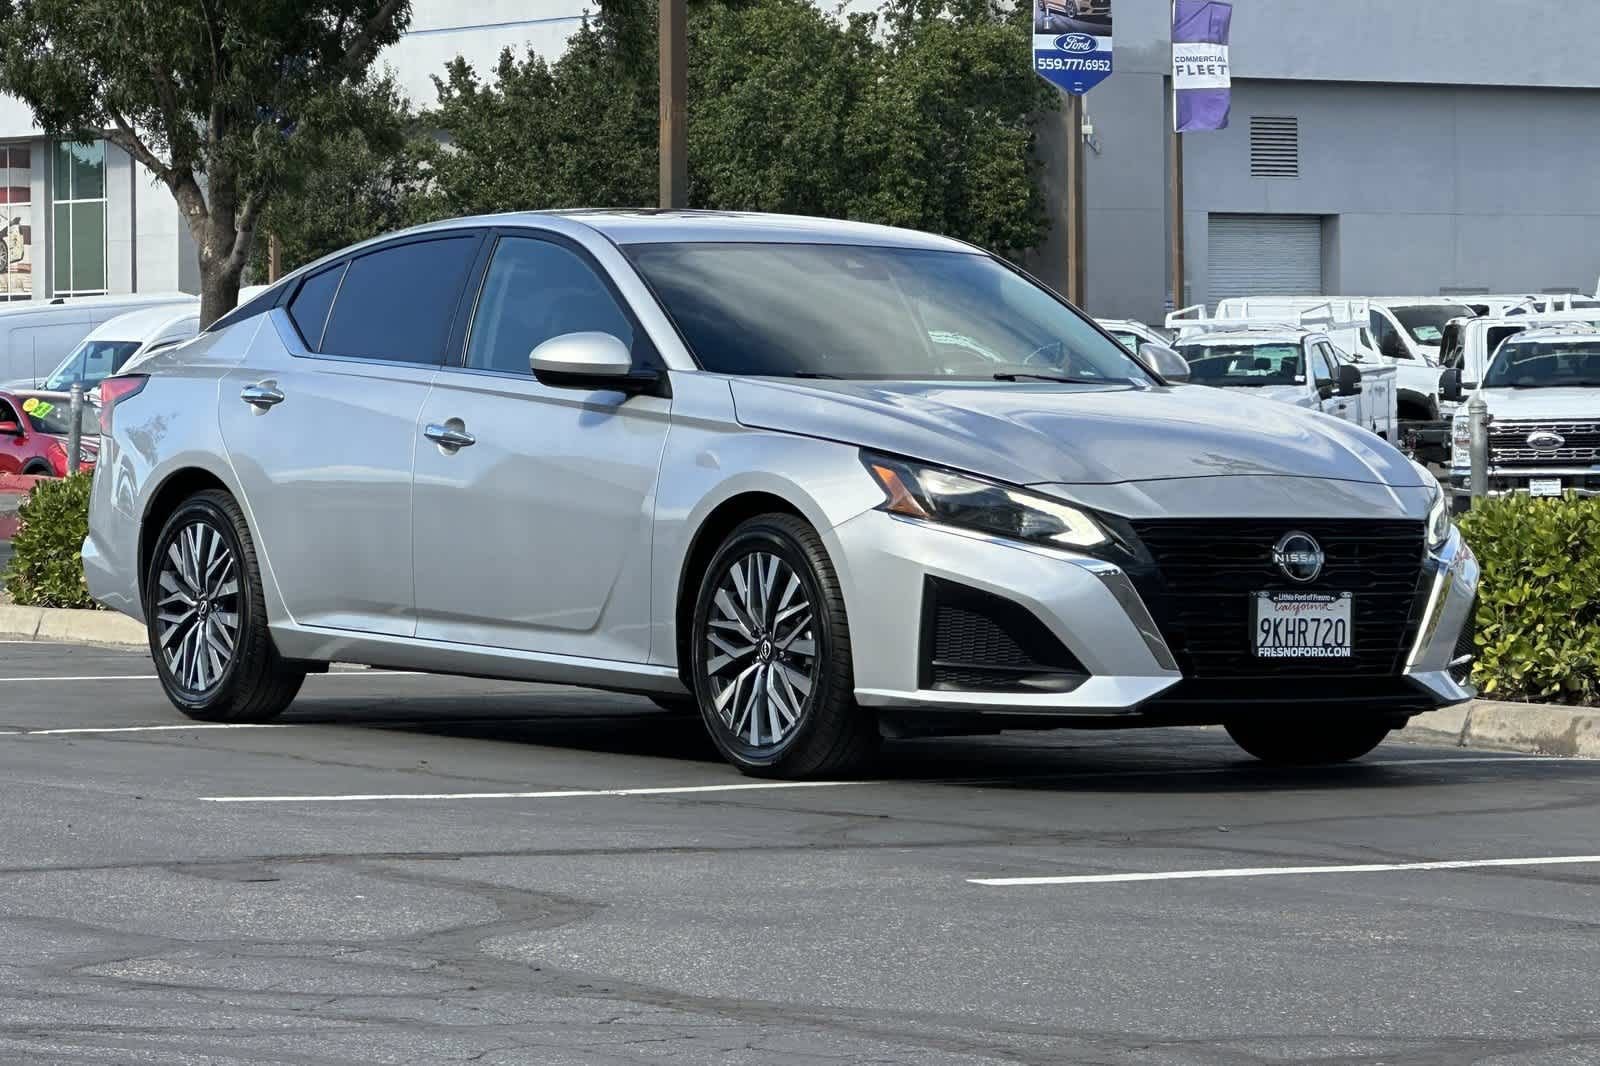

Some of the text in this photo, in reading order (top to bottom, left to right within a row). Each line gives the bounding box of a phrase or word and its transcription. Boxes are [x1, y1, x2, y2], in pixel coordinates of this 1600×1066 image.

[1063, 35, 1091, 51] Ford
[1037, 57, 1111, 72] 559.777.6952
[1174, 55, 1227, 64] COMMERCIAL
[1176, 64, 1228, 76] FLEET
[1274, 552, 1325, 564] NISSAN
[1294, 593, 1307, 601] Ford
[1260, 618, 1346, 647] 9KHR720
[1258, 647, 1351, 657] FRESNOFORD.COM
